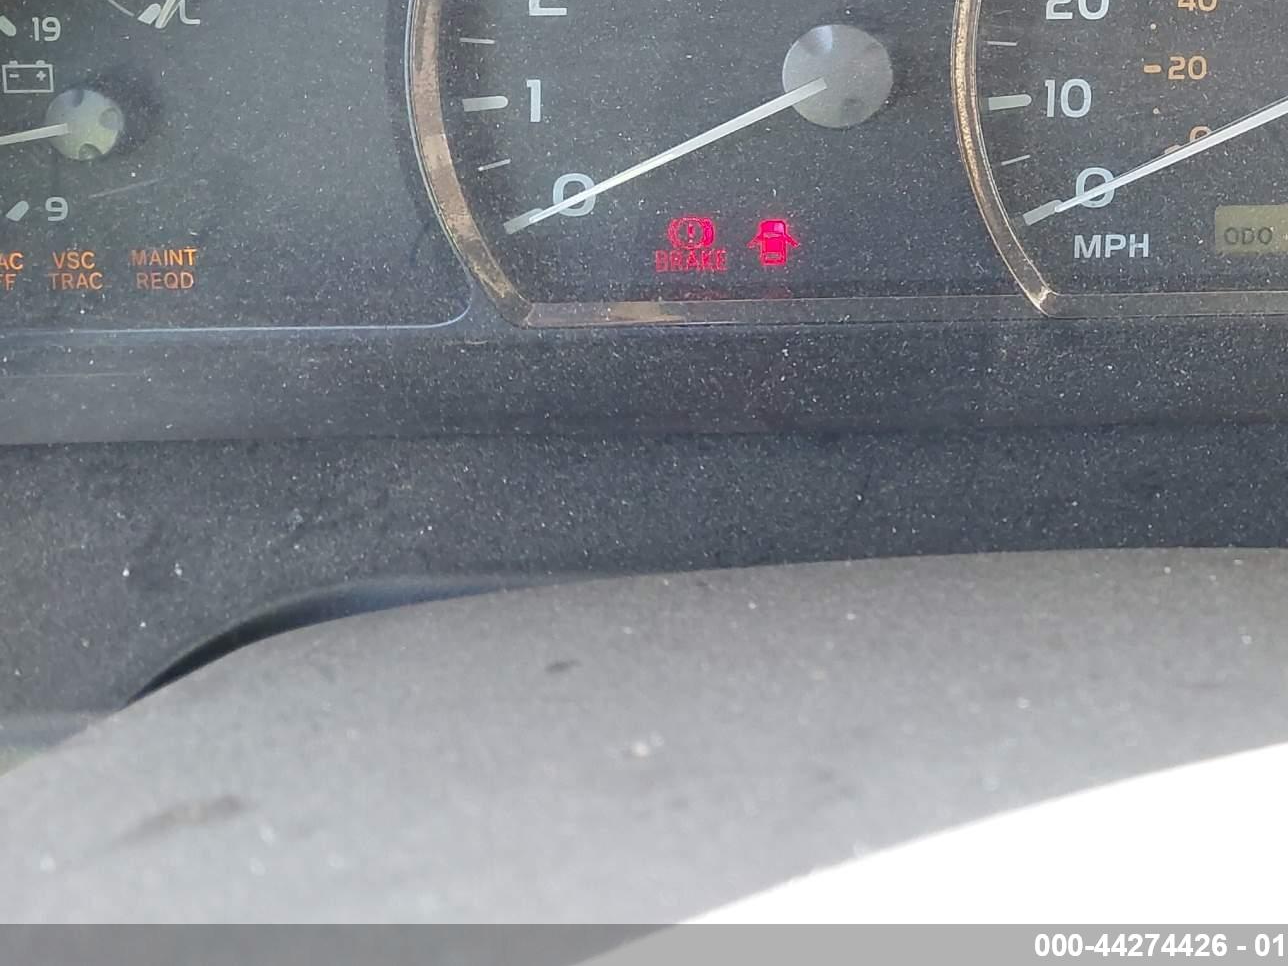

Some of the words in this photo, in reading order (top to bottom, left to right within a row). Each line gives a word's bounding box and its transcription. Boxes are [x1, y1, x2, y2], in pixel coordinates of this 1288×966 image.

[32, 16, 60, 42] 19
[1167, 56, 1207, 80] 20
[526, 79, 542, 122] 1
[1044, 79, 1092, 117] 10
[551, 173, 596, 216] 0
[1075, 167, 1115, 207] 0
[45, 198, 68, 221] 9
[1074, 234, 1149, 258] MPH
[1224, 226, 1273, 246] ODO
[52, 251, 96, 269] VSC
[131, 249, 198, 266] MAINT
[655, 251, 727, 271] BRAKE
[47, 272, 103, 289] TRAC
[137, 272, 194, 289] REQD
